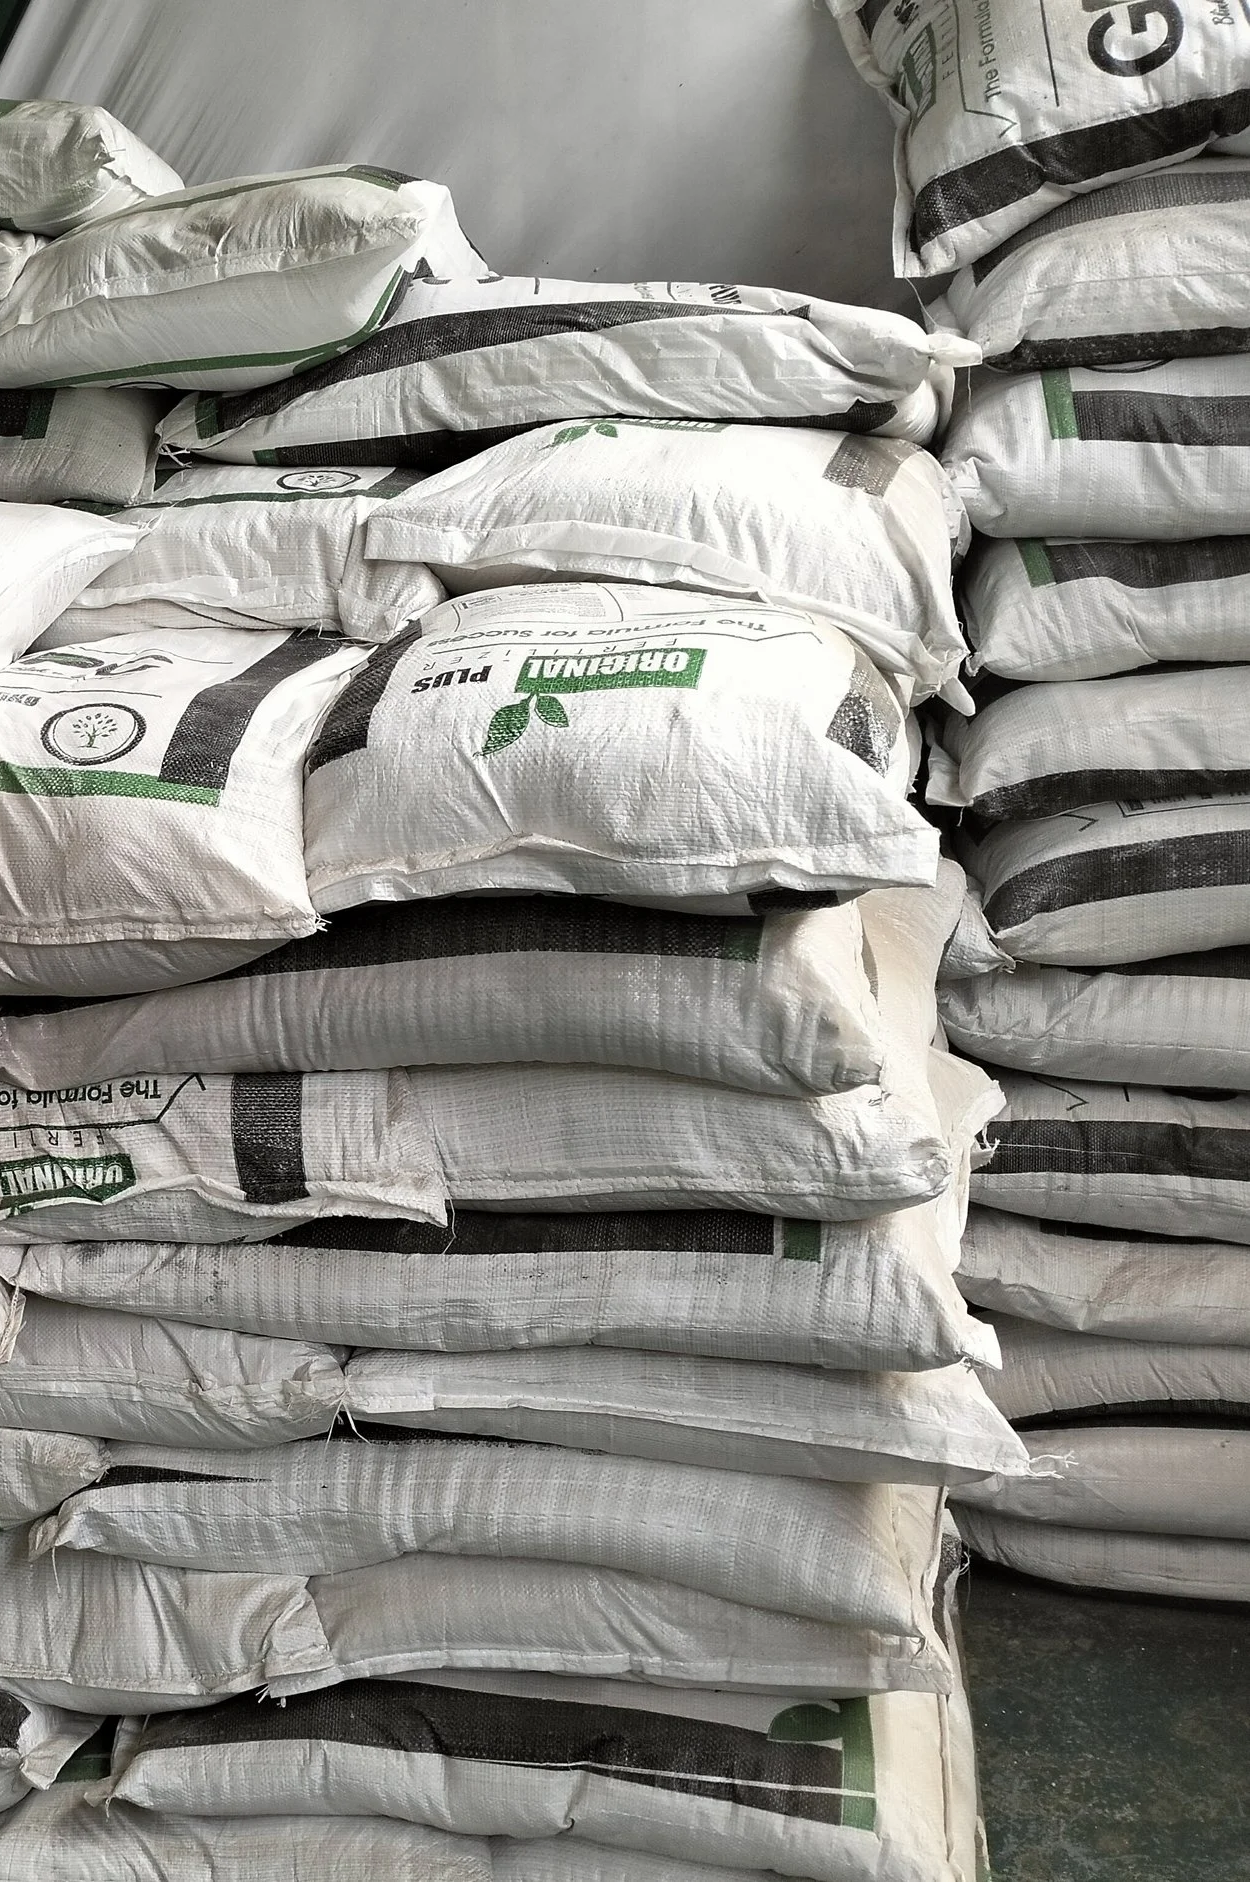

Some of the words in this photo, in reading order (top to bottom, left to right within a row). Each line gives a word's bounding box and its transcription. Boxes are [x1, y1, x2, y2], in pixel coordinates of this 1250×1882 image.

[974, 0, 997, 67] Formula
[984, 69, 1002, 103] The
[427, 630, 534, 648] Success
[587, 619, 707, 636] Formula
[423, 638, 678, 671] FERTILIZER
[527, 650, 690, 679] ORIGINAL
[410, 664, 493, 694] PLUS
[25, 1084, 113, 1108] Formula
[119, 1079, 162, 1100] The
